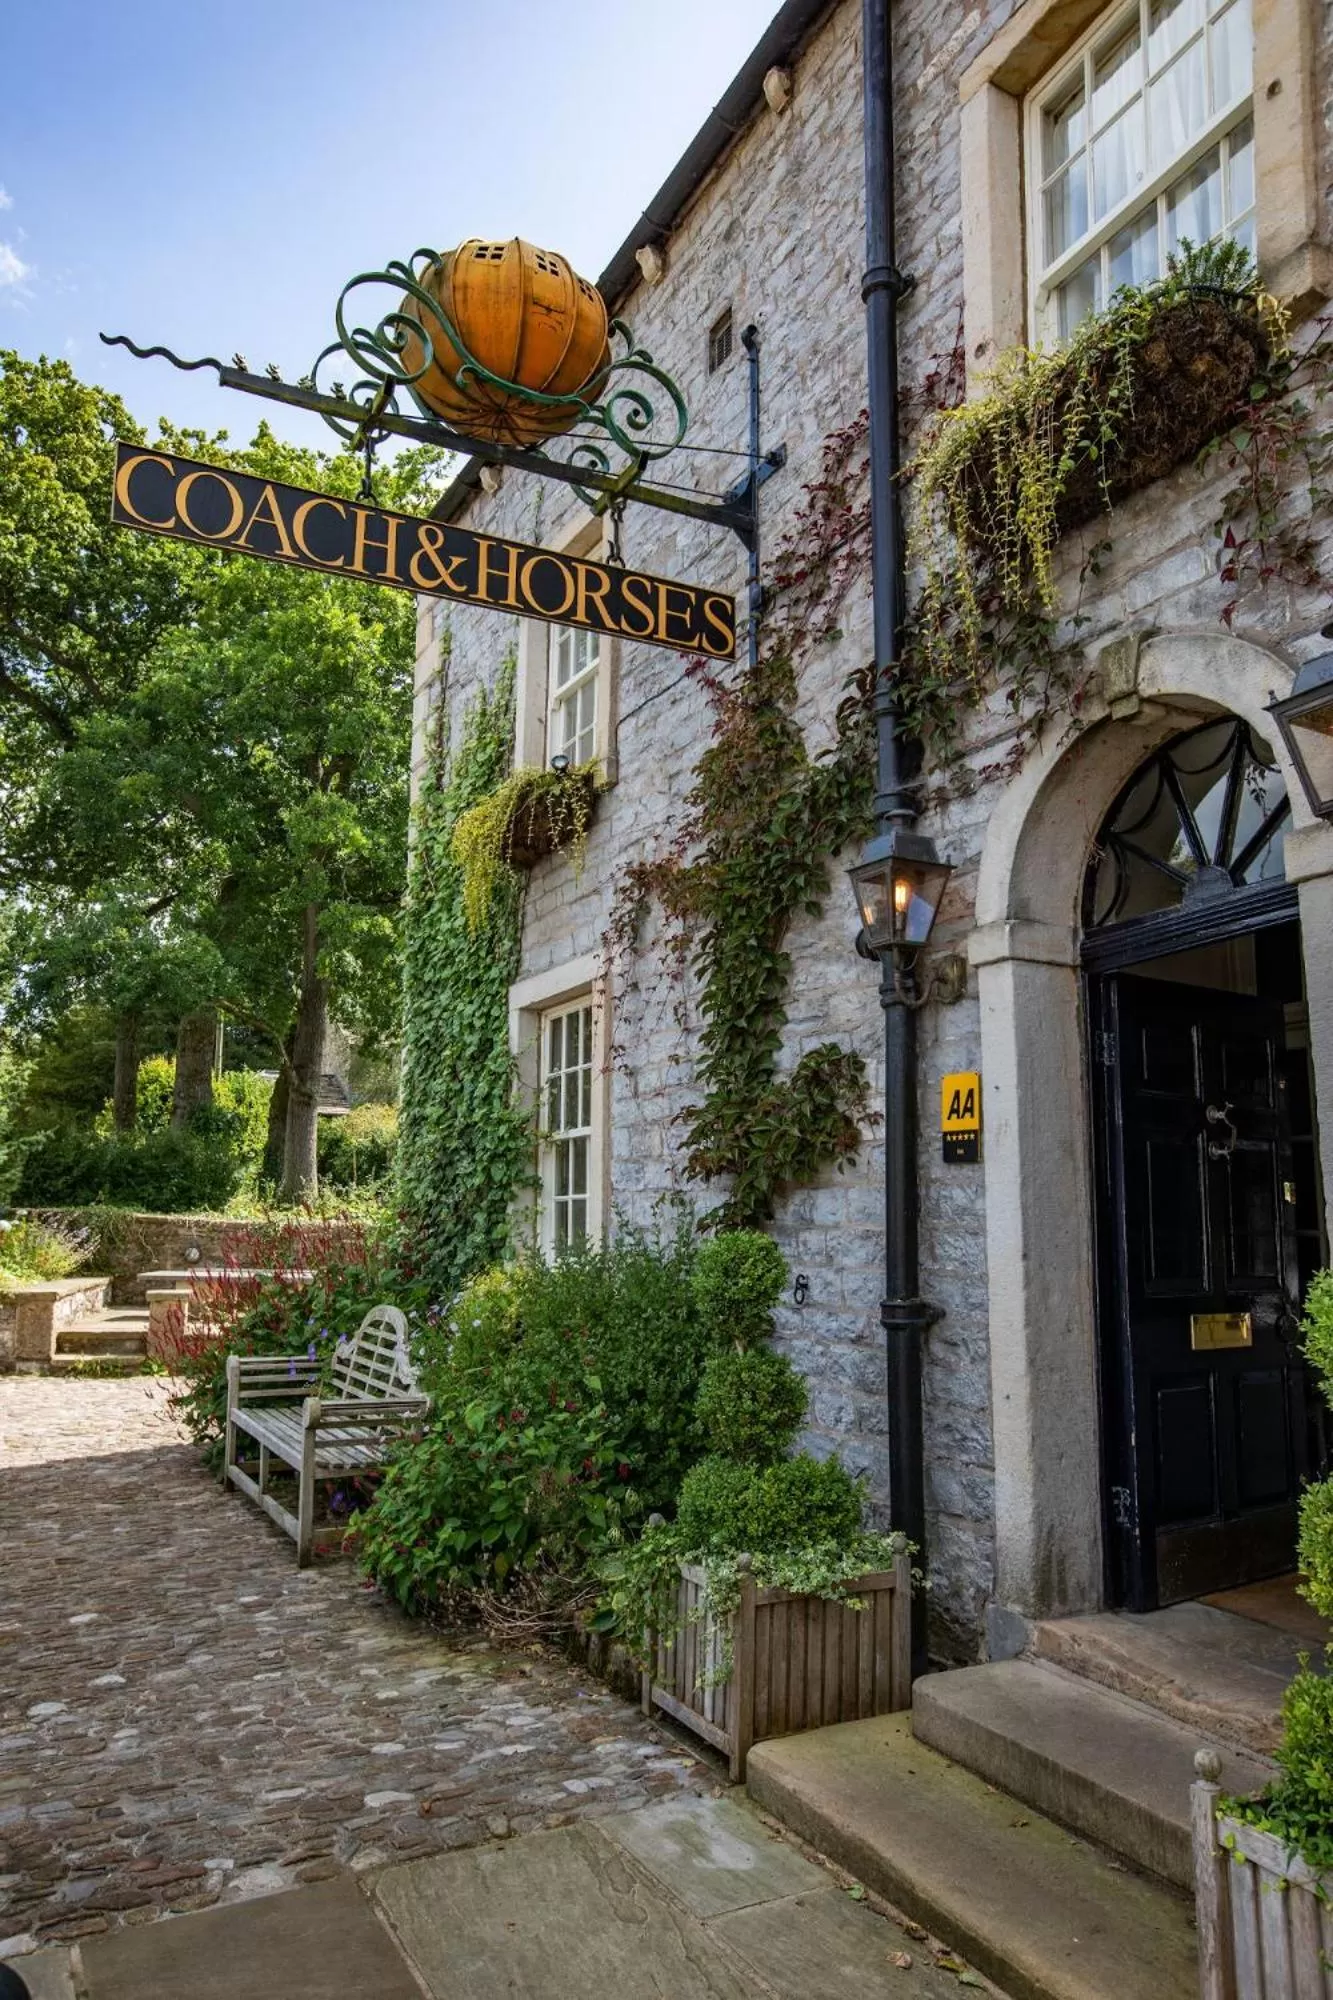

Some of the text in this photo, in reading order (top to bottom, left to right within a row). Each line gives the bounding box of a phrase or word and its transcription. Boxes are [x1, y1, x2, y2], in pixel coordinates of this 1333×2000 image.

[116, 455, 735, 655] COACH & HORSES
[947, 1088, 975, 1120] AA
